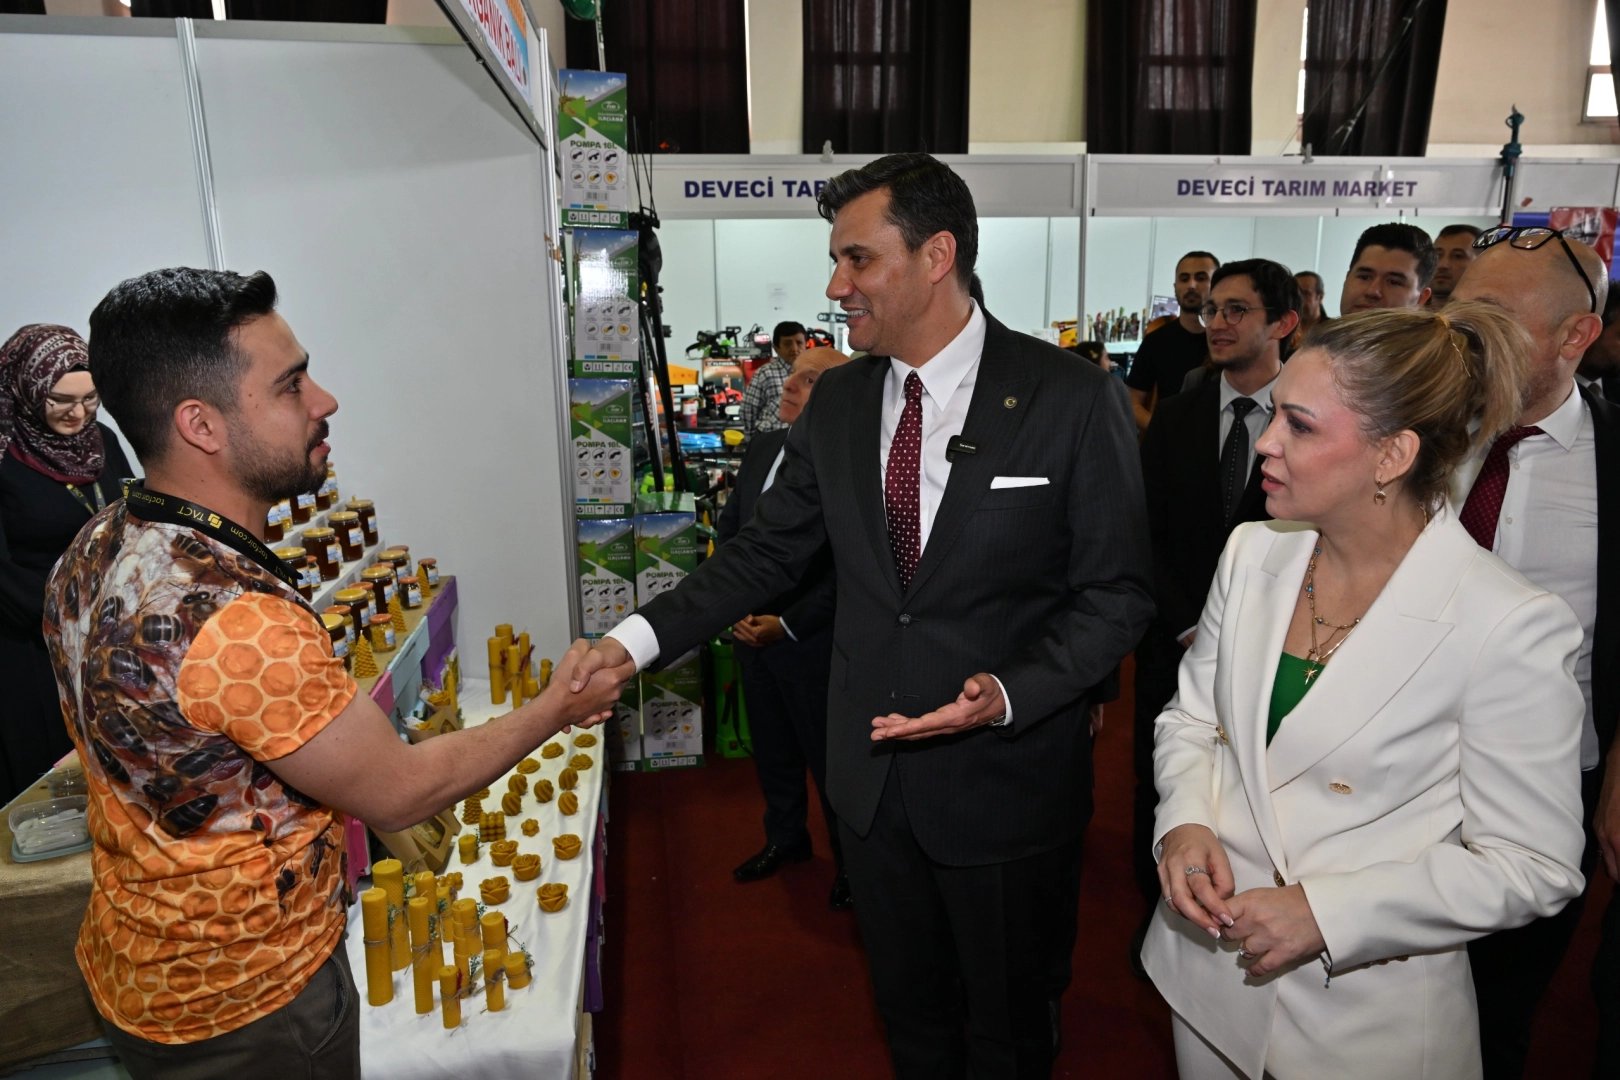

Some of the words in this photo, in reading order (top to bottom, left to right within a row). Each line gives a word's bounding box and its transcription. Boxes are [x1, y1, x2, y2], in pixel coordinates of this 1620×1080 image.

[570, 140, 601, 148] POMPA
[684, 176, 773, 198] DEVECİ
[1177, 175, 1255, 196] DEVECİ
[1262, 180, 1326, 197] TARIM
[1332, 181, 1417, 198] MARKET
[177, 505, 204, 522] TACT
[230, 526, 268, 560] tacfair.com
